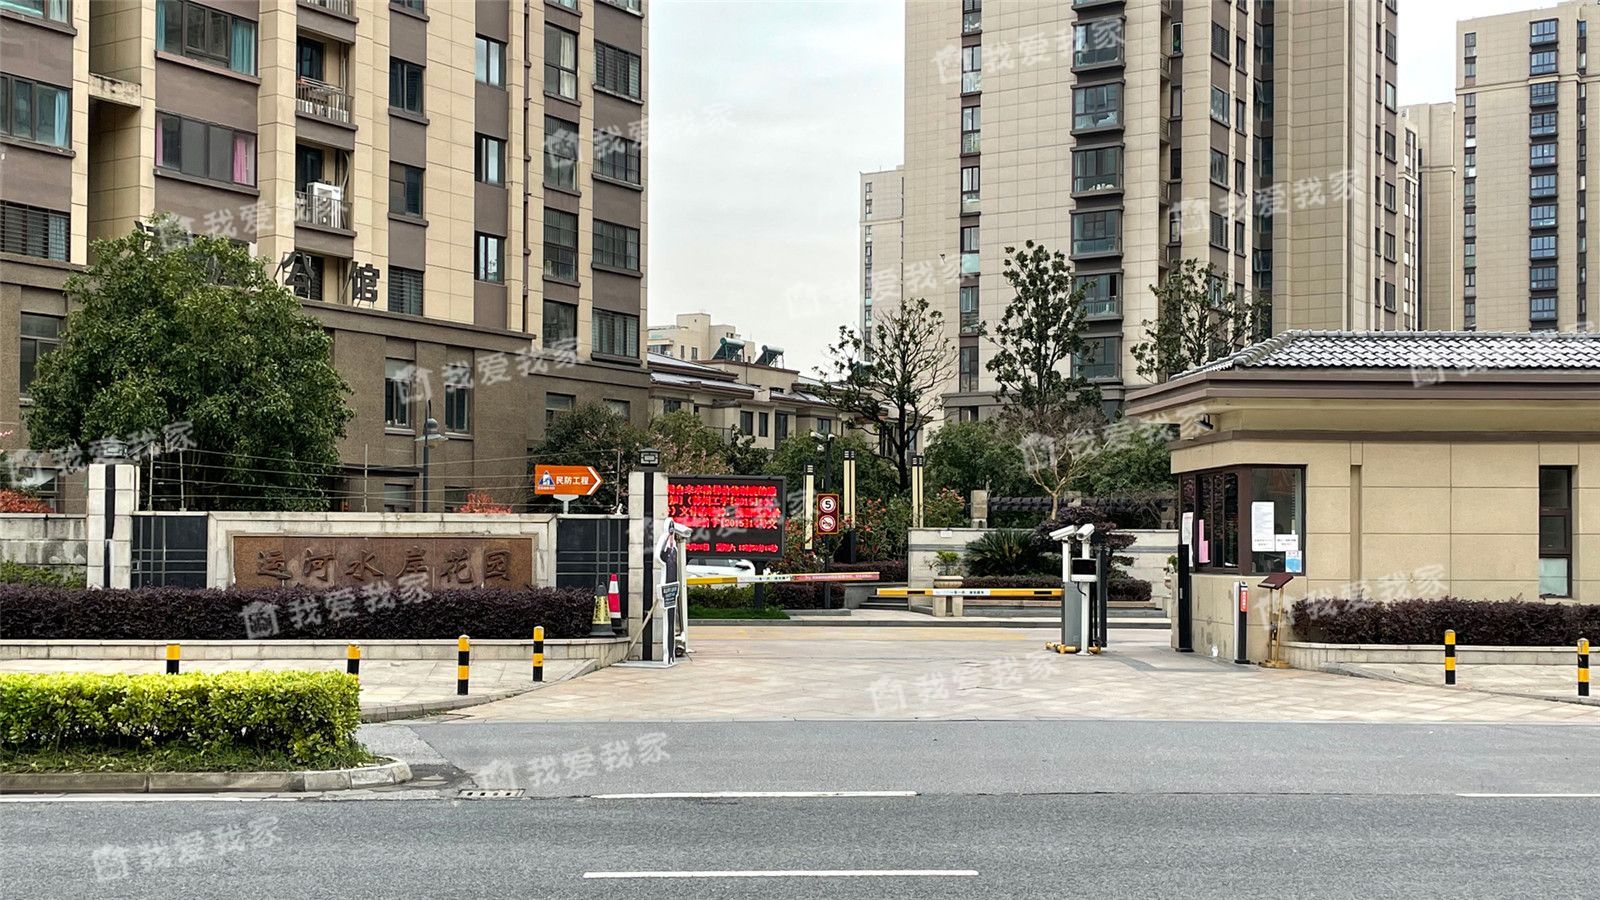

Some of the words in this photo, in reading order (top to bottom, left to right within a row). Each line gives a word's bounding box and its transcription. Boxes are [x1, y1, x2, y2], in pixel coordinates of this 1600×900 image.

[556, 476, 589, 485] 民防工程
[825, 500, 832, 509] 5
[256, 547, 511, 584] 运河水岸花园
